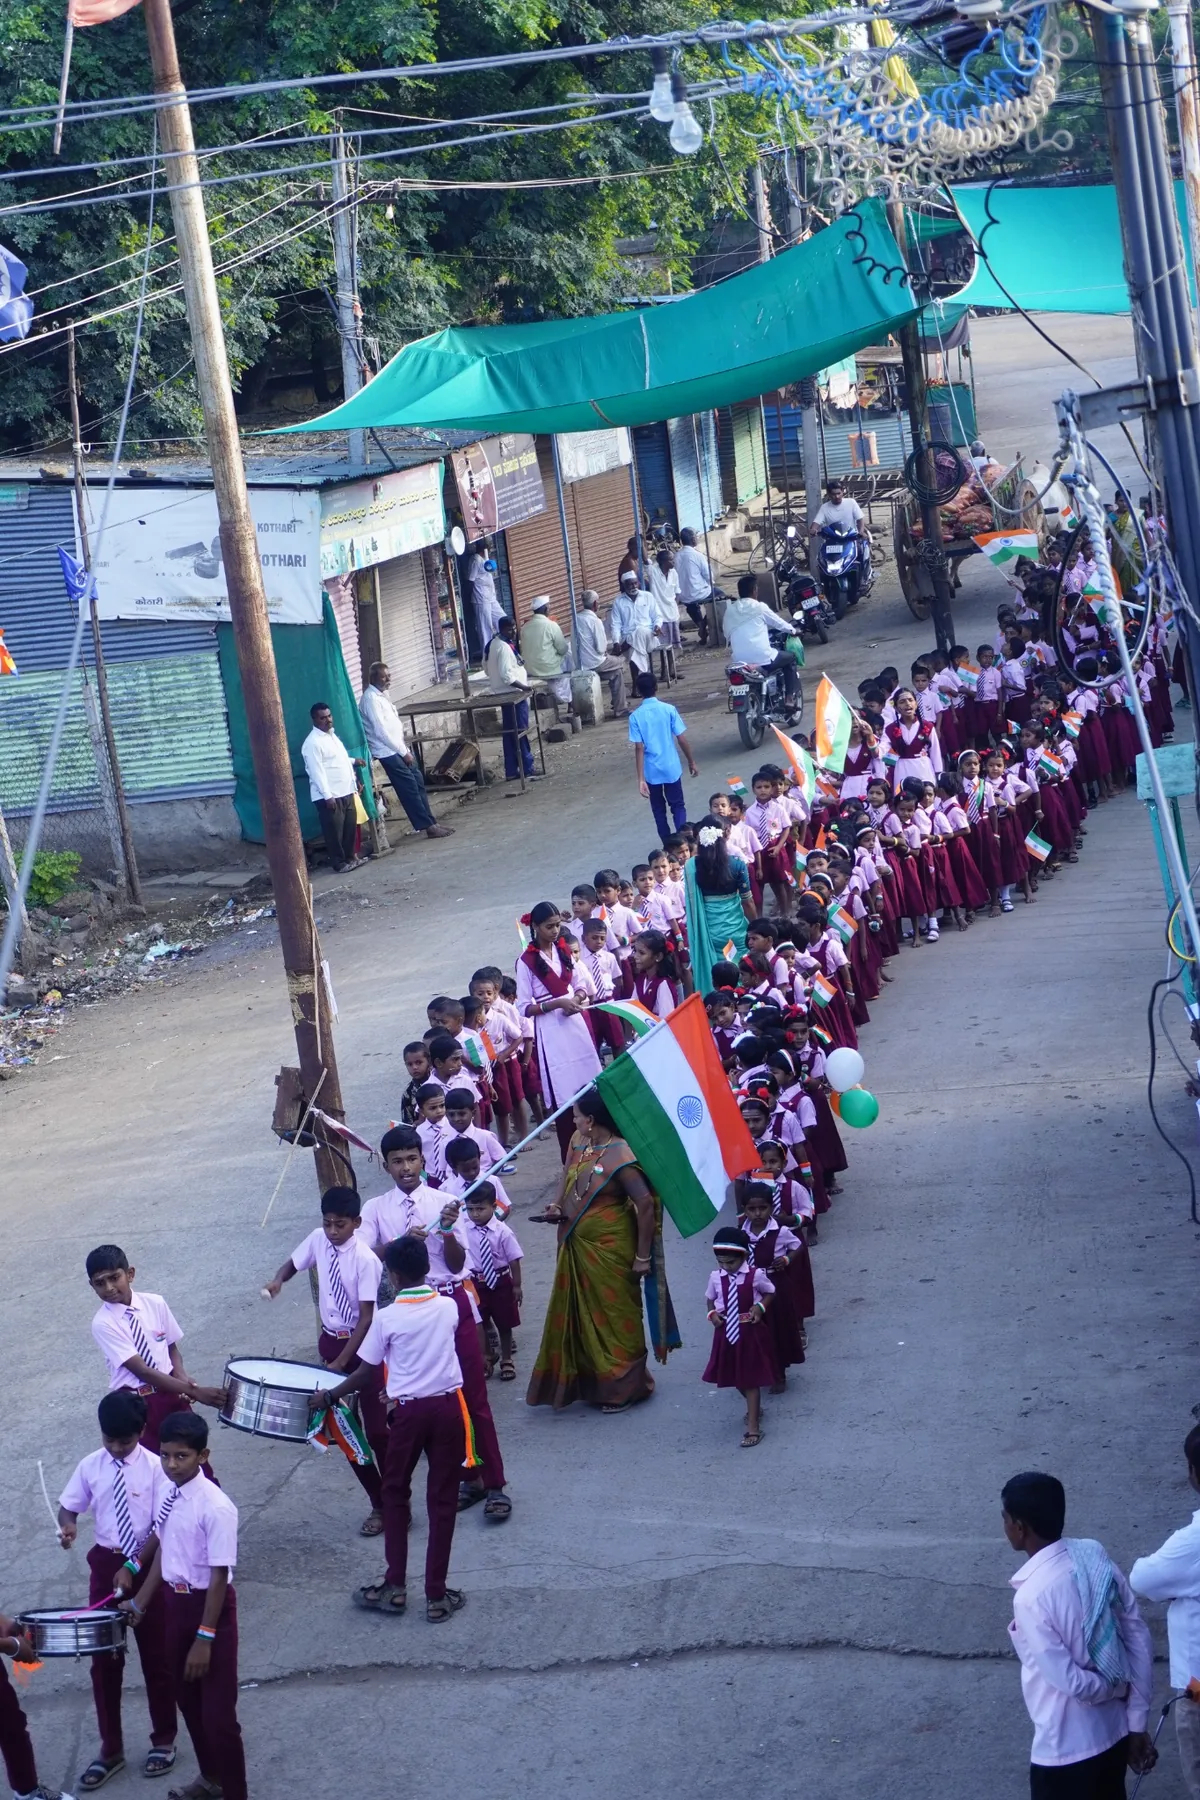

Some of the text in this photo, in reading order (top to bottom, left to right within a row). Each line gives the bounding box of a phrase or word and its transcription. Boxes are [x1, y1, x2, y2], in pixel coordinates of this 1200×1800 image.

[257, 522, 296, 533] KOTHARI
[259, 553, 306, 567] OTHARI
[135, 596, 163, 606] कोठारी
